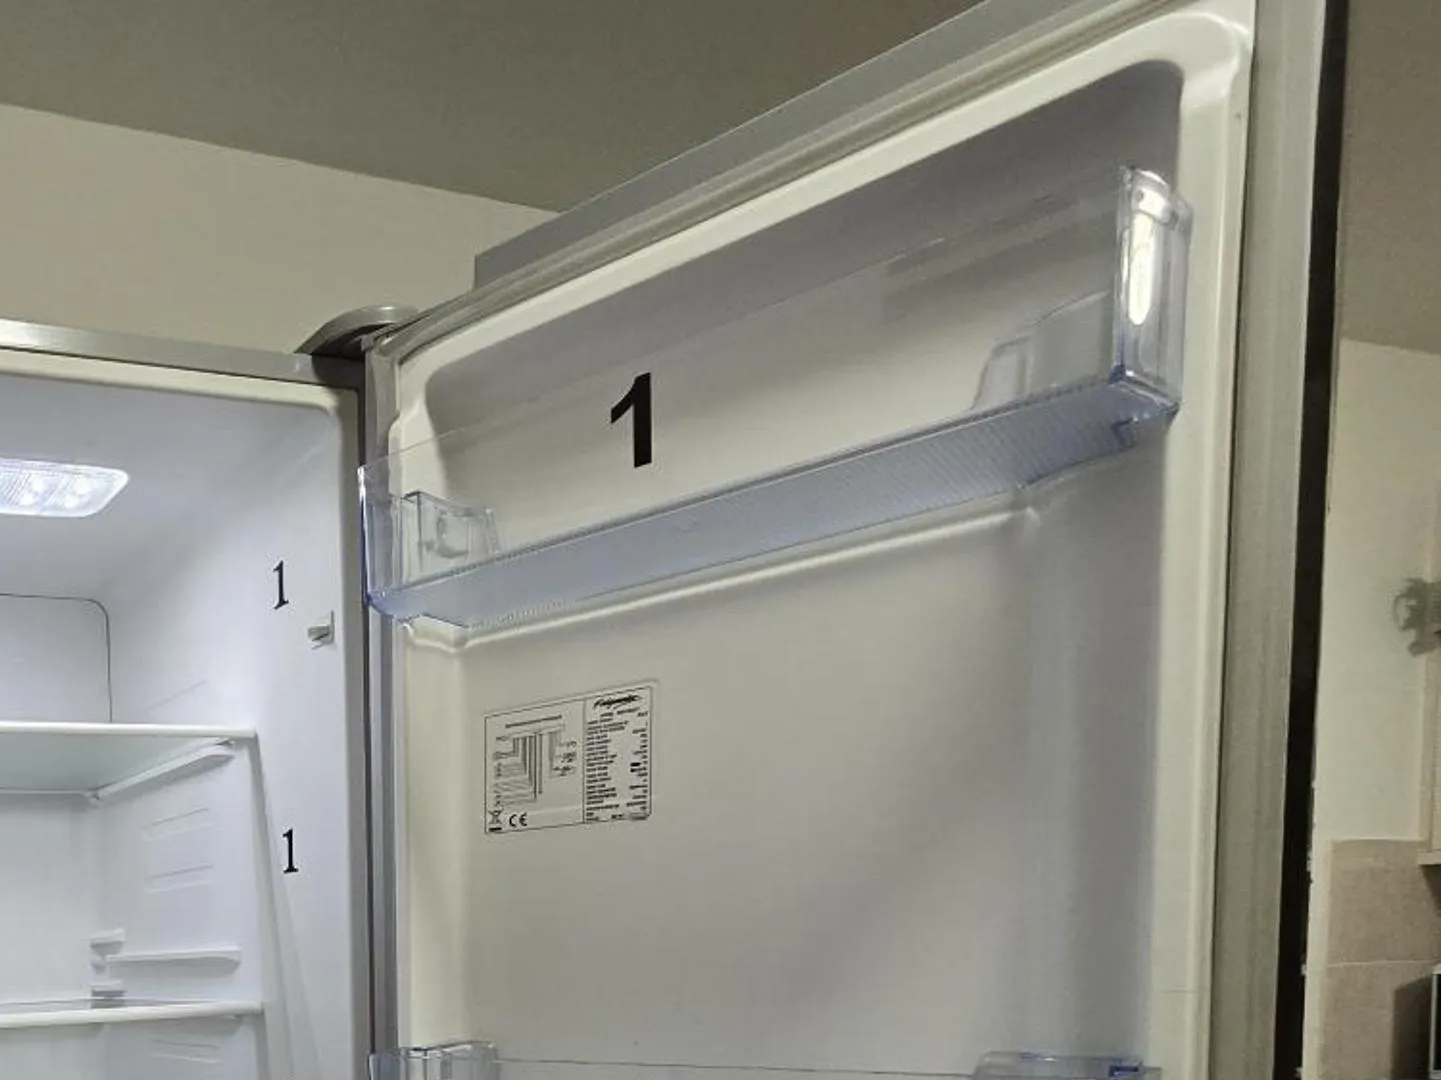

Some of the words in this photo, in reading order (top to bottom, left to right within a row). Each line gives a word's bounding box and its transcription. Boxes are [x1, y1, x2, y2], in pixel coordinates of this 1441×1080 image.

[610, 372, 652, 468] 1
[274, 561, 289, 610] 1
[282, 829, 298, 874] 1
